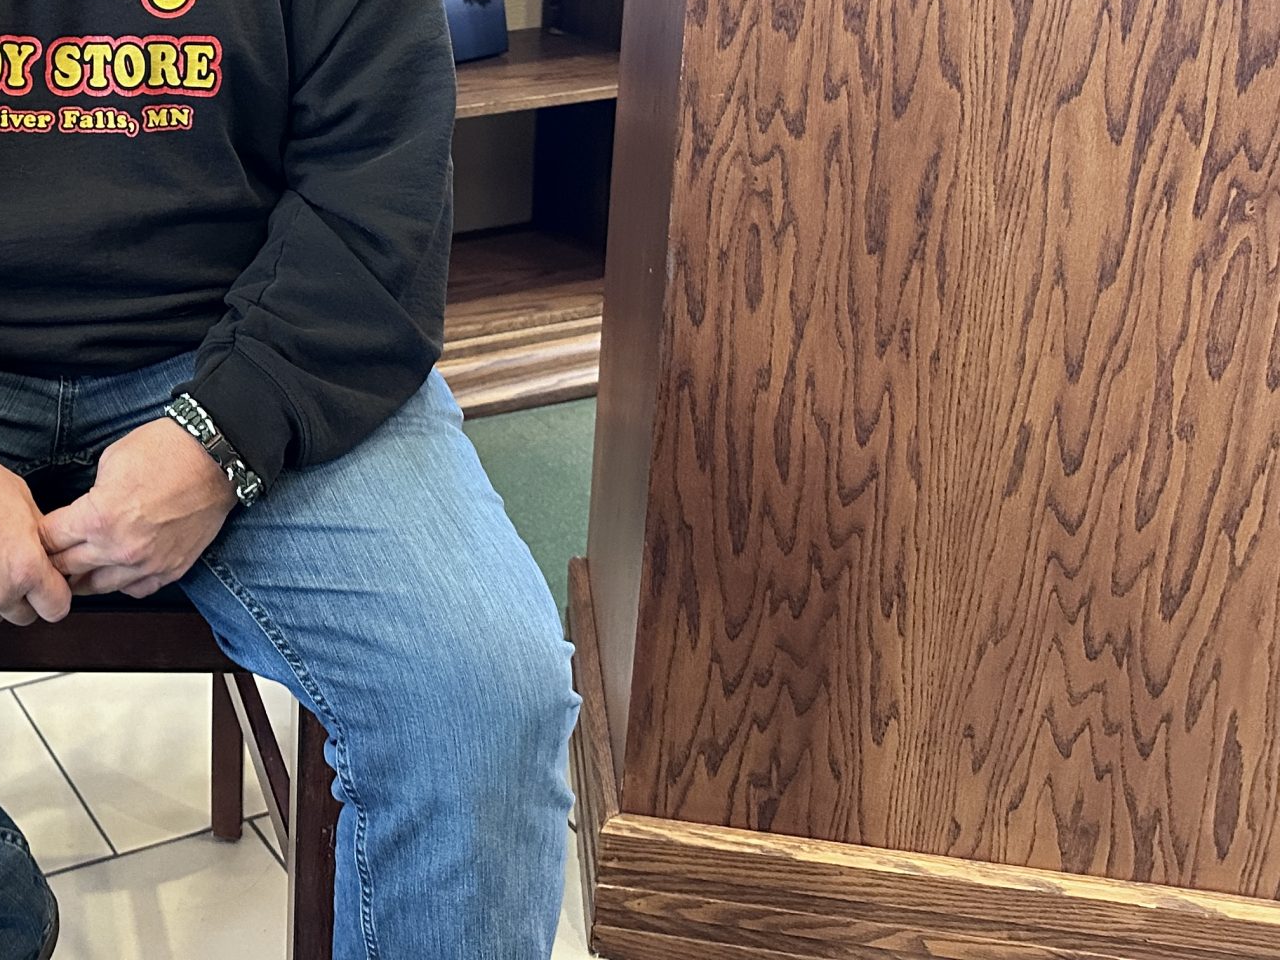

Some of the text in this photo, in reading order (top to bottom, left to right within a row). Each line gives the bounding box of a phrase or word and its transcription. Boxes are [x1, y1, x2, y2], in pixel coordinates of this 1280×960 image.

[51, 39, 218, 92] STORE
[61, 108, 137, 134] Falls,
[144, 106, 190, 129] MN
